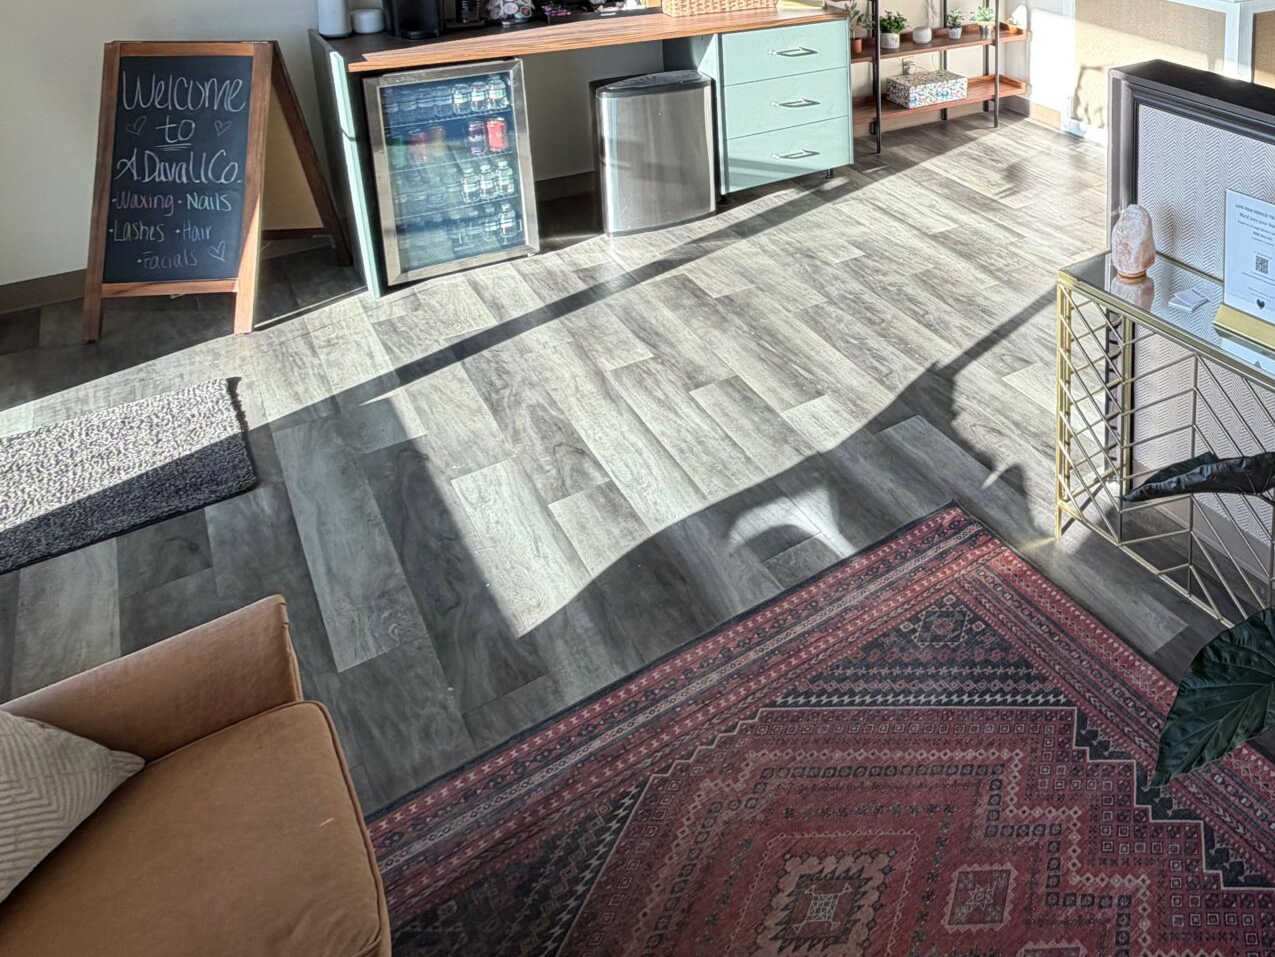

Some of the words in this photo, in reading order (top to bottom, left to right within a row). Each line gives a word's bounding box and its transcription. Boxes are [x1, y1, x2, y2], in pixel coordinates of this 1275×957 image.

[122, 70, 246, 112] Welcome
[155, 115, 195, 143] to
[116, 191, 174, 216] Waxing
[186, 192, 232, 212] Nails
[114, 220, 165, 242] Lashes
[182, 220, 212, 242] Hair
[142, 248, 199, 269] Facials
